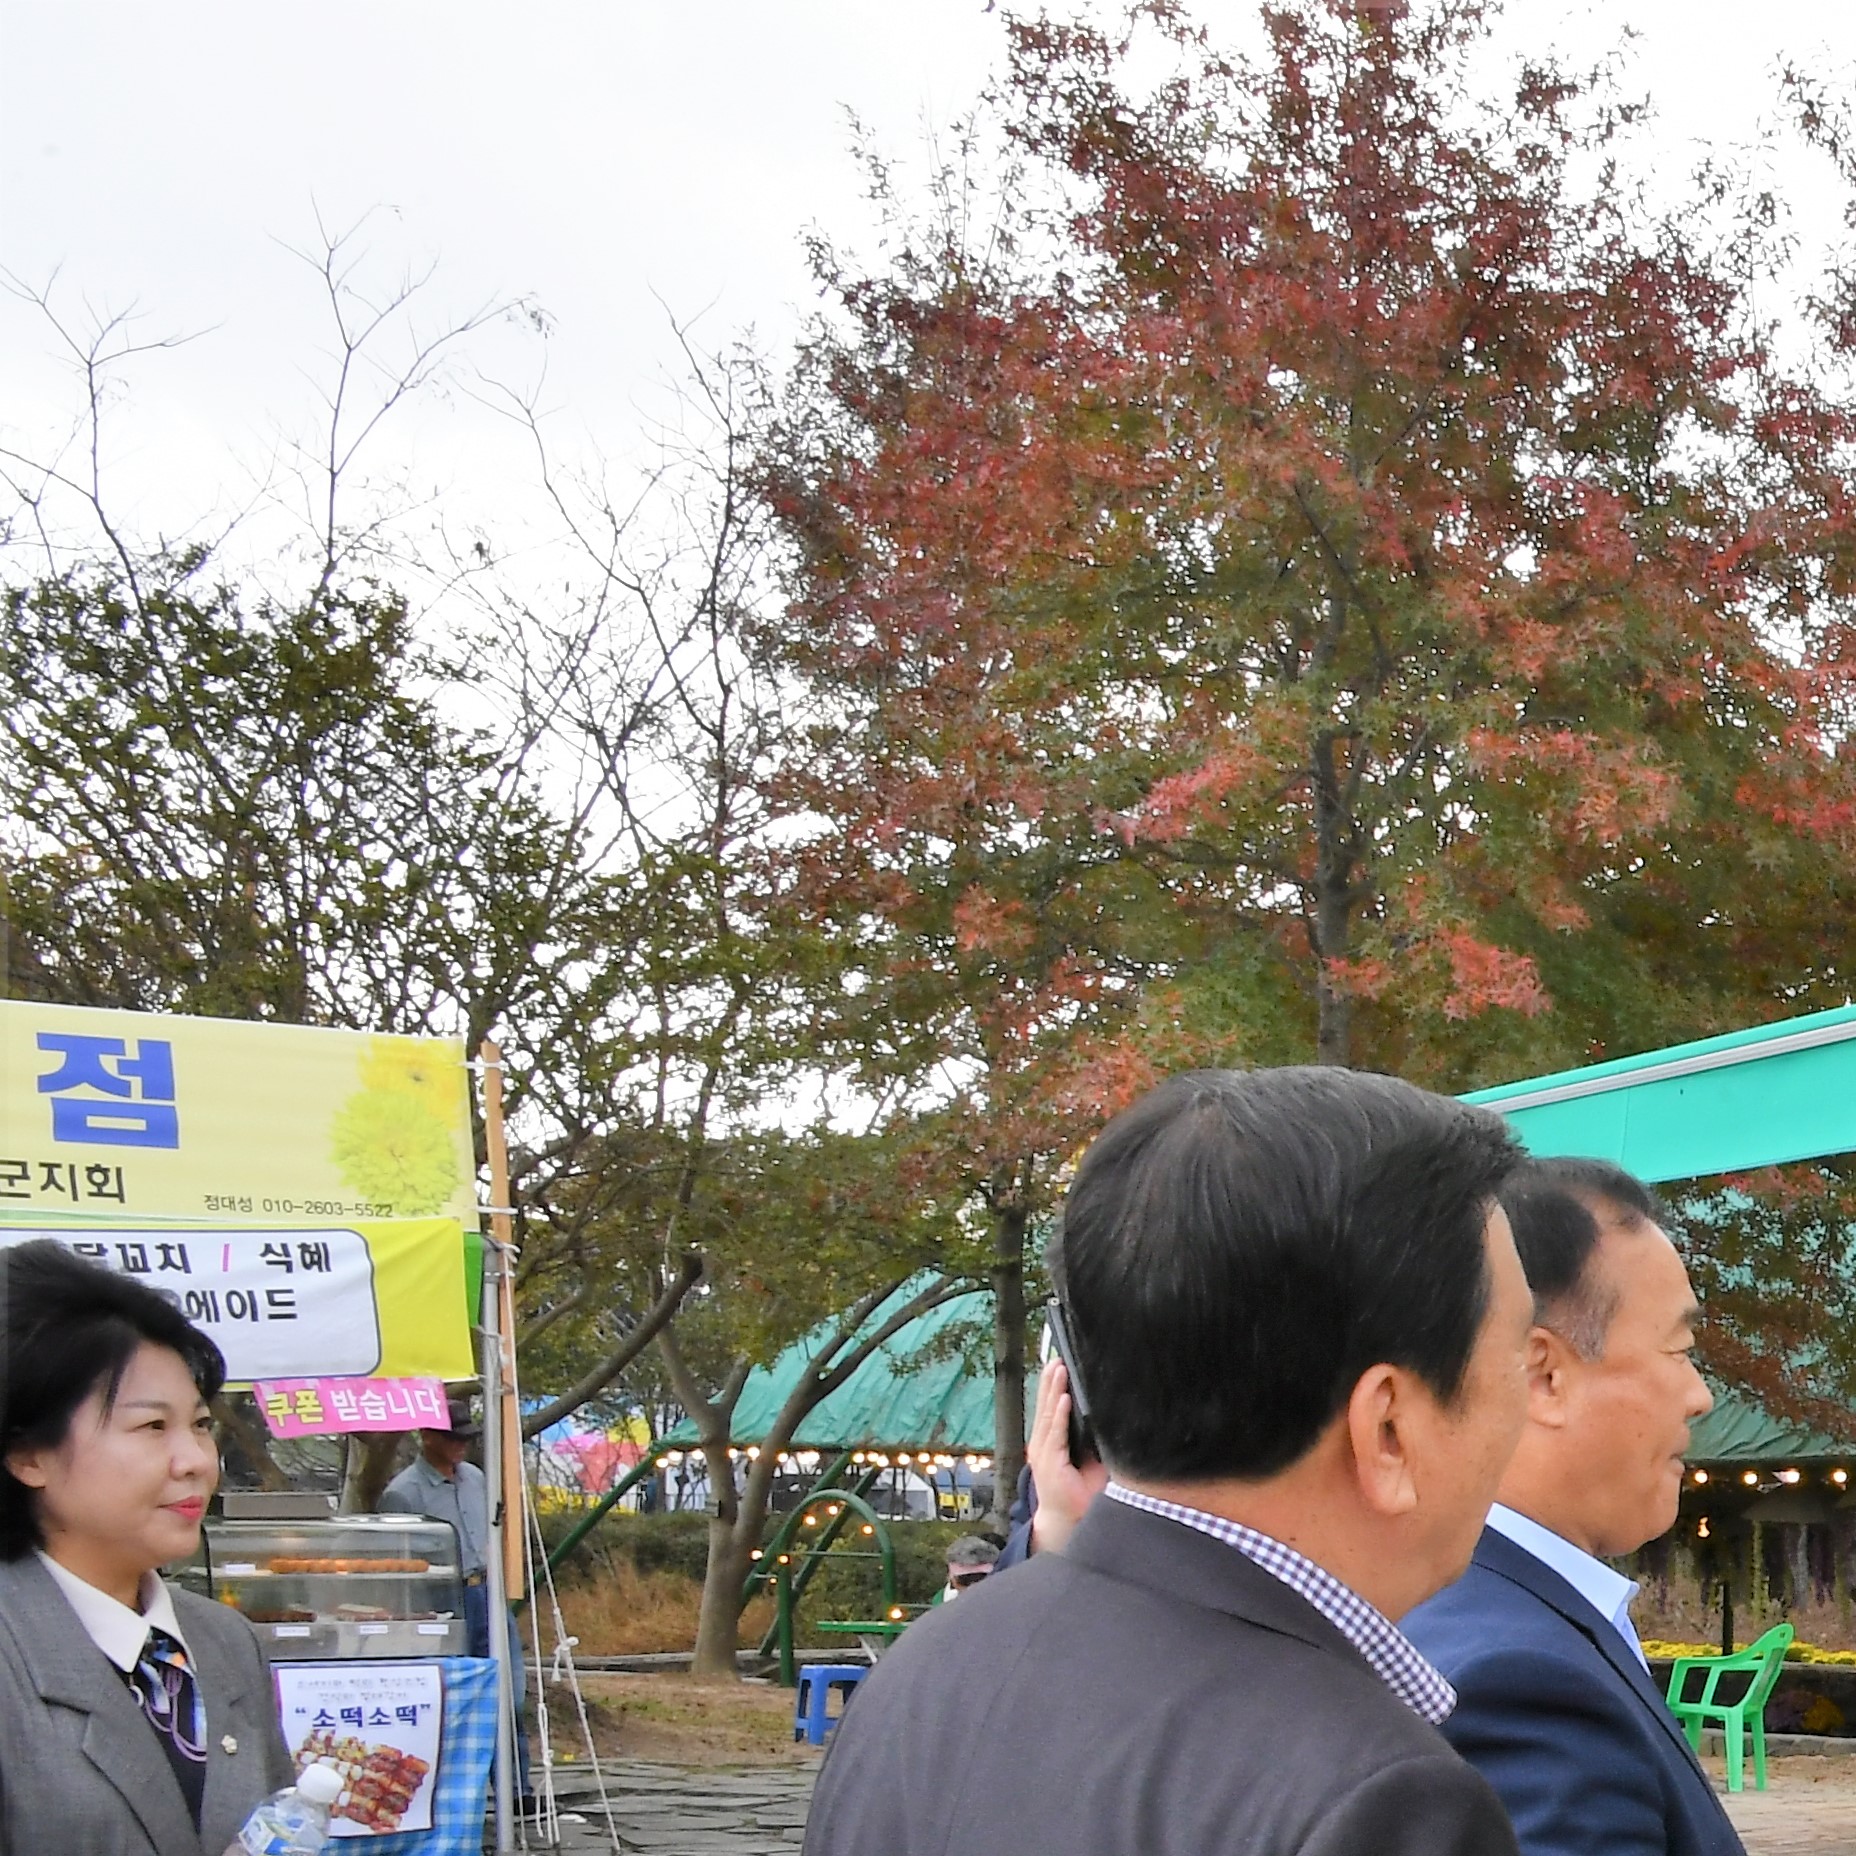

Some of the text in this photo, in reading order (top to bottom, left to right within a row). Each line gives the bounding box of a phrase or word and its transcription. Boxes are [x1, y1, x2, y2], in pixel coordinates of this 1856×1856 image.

[36, 1031, 180, 1150] 점
[204, 1194, 395, 1218] 정대성 010-2603-5522
[258, 1241, 333, 1274] 식혜
[266, 1388, 442, 1428] 쿠폰 받습니다
